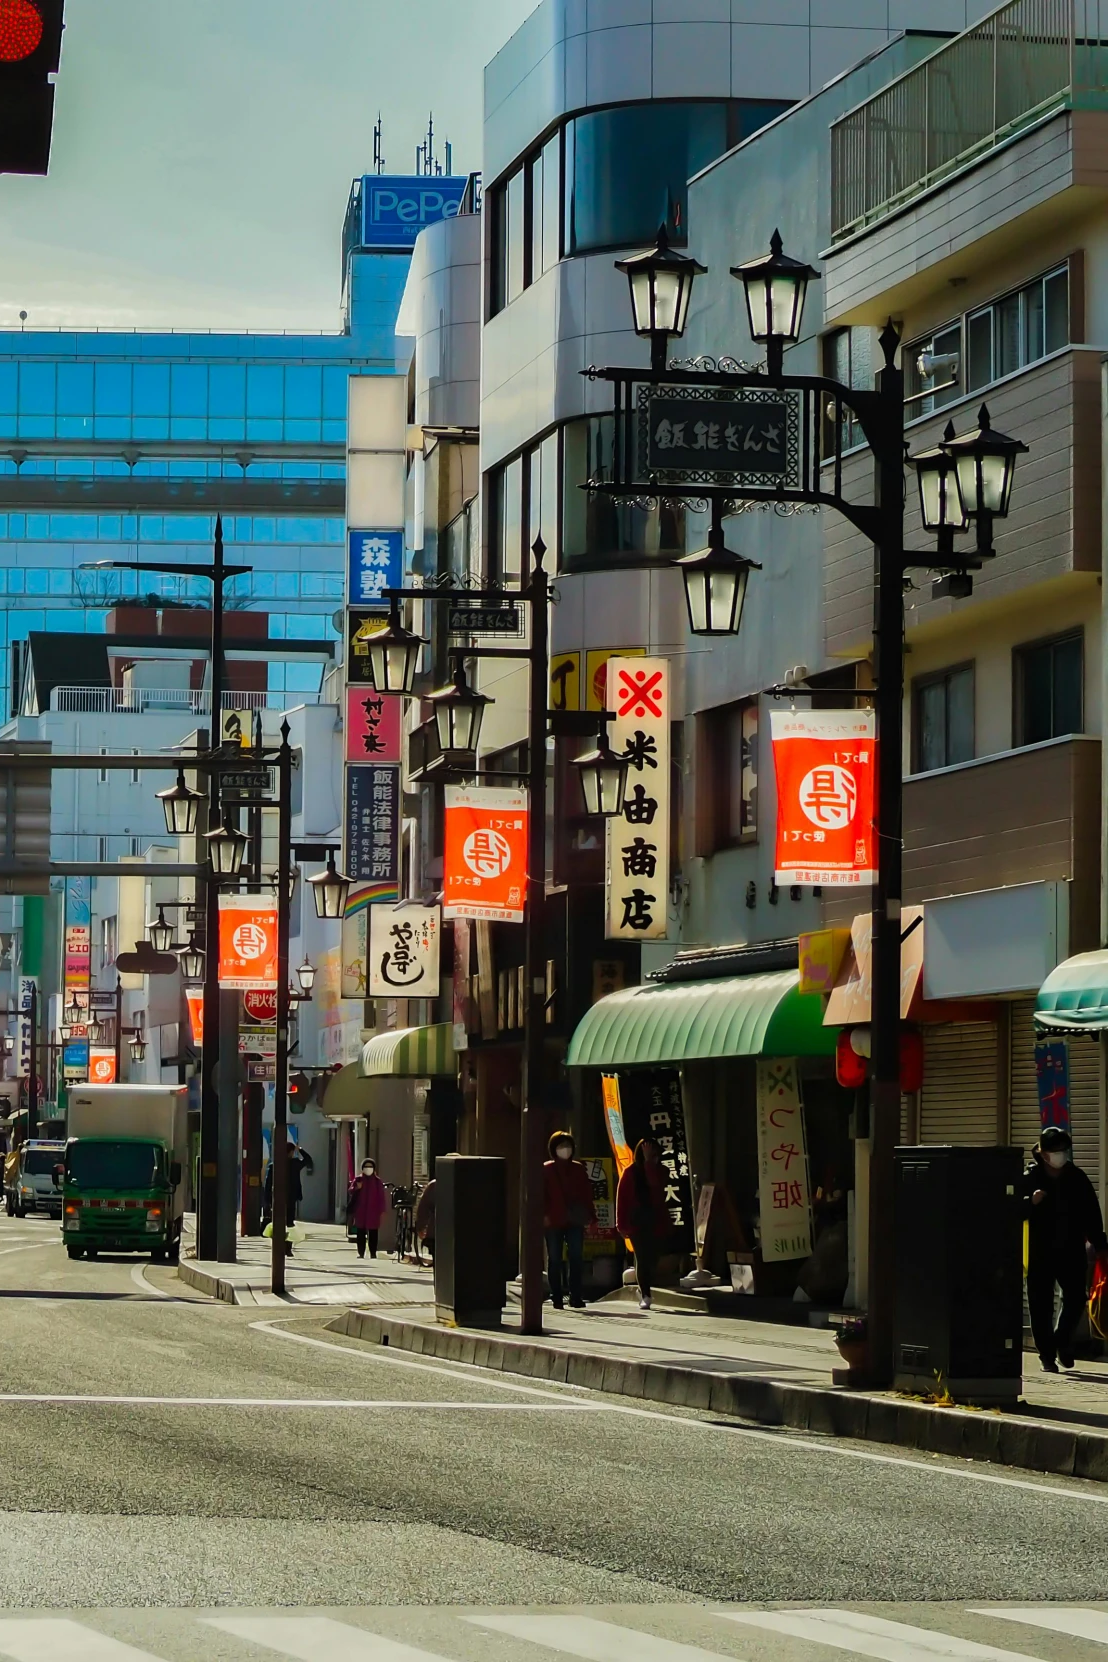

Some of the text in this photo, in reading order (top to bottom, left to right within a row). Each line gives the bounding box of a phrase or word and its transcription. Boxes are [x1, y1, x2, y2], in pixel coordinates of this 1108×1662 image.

[373, 190, 461, 222] PePe
[653, 418, 785, 454] 飯能ぎんざ
[360, 537, 391, 599] 森塾
[452, 612, 515, 629] 飯能ぎんざ
[351, 777, 359, 796] TEL
[372, 770, 393, 877] 飯能法律事務所
[620, 730, 659, 931] 米由商店
[68, 944, 89, 953] ピエロ
